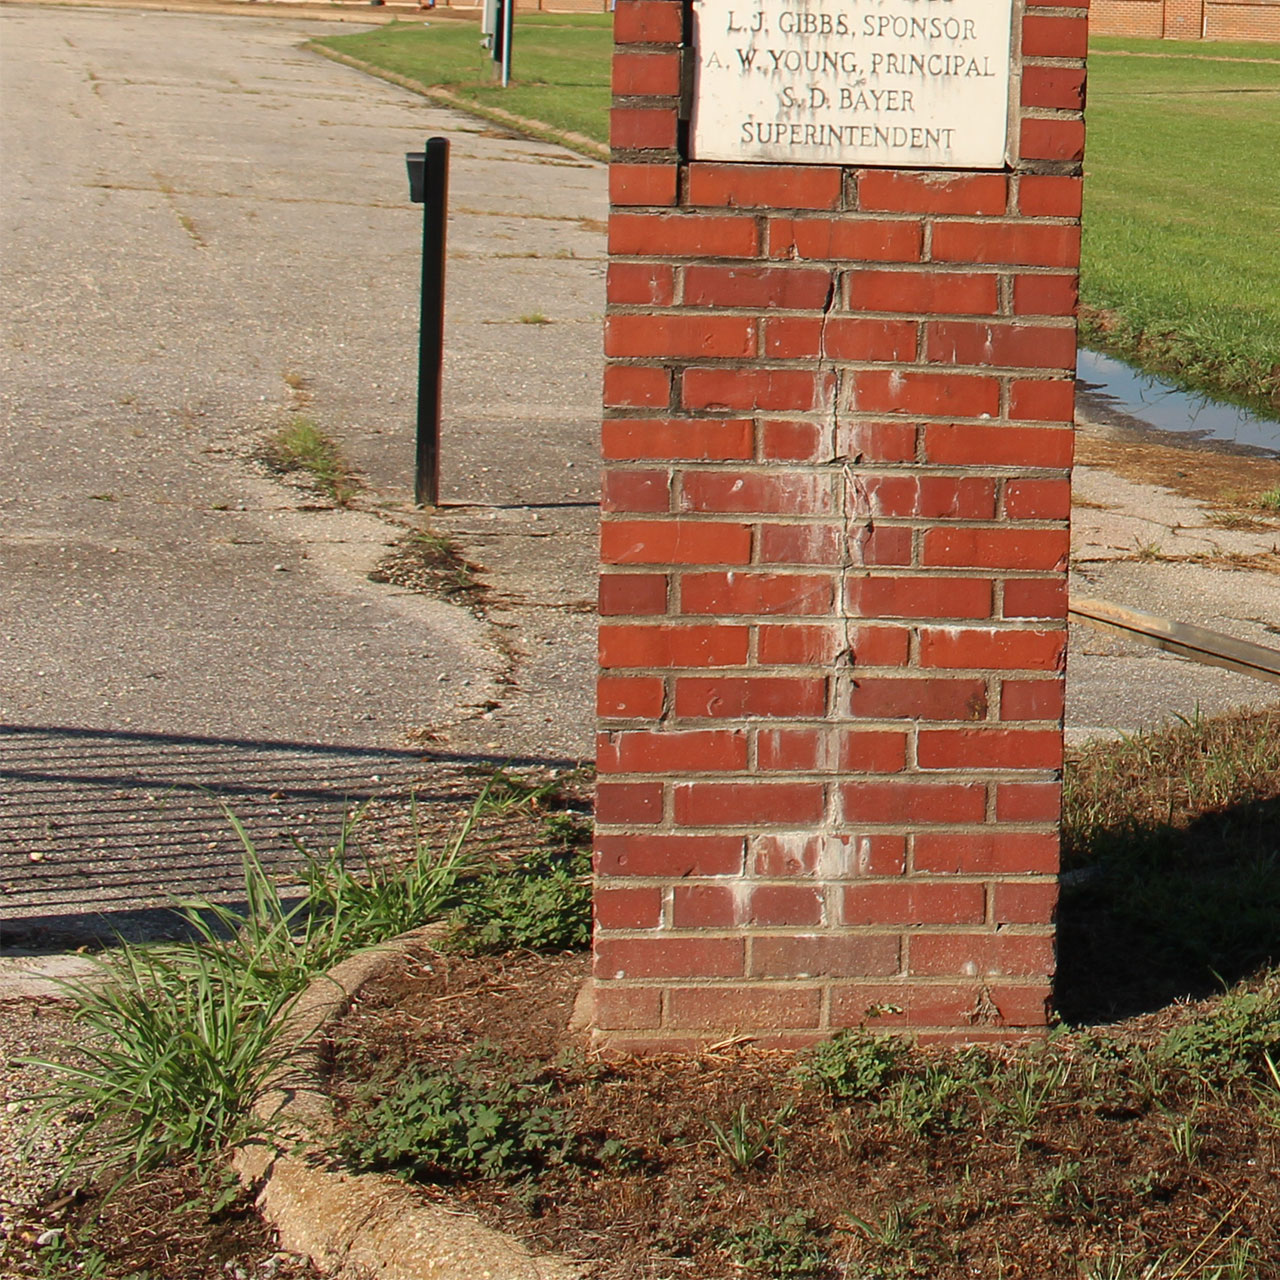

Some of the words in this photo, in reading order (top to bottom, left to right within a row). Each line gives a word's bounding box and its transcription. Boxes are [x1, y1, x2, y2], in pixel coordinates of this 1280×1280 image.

[778, 12, 856, 38] GIBBS,
[863, 15, 977, 40] SPONSOR
[767, 49, 863, 76] YOUNG,
[871, 53, 996, 78] PRINCIPAL
[839, 88, 916, 112] BAYER
[740, 121, 956, 150] SUPERINTENDENT
